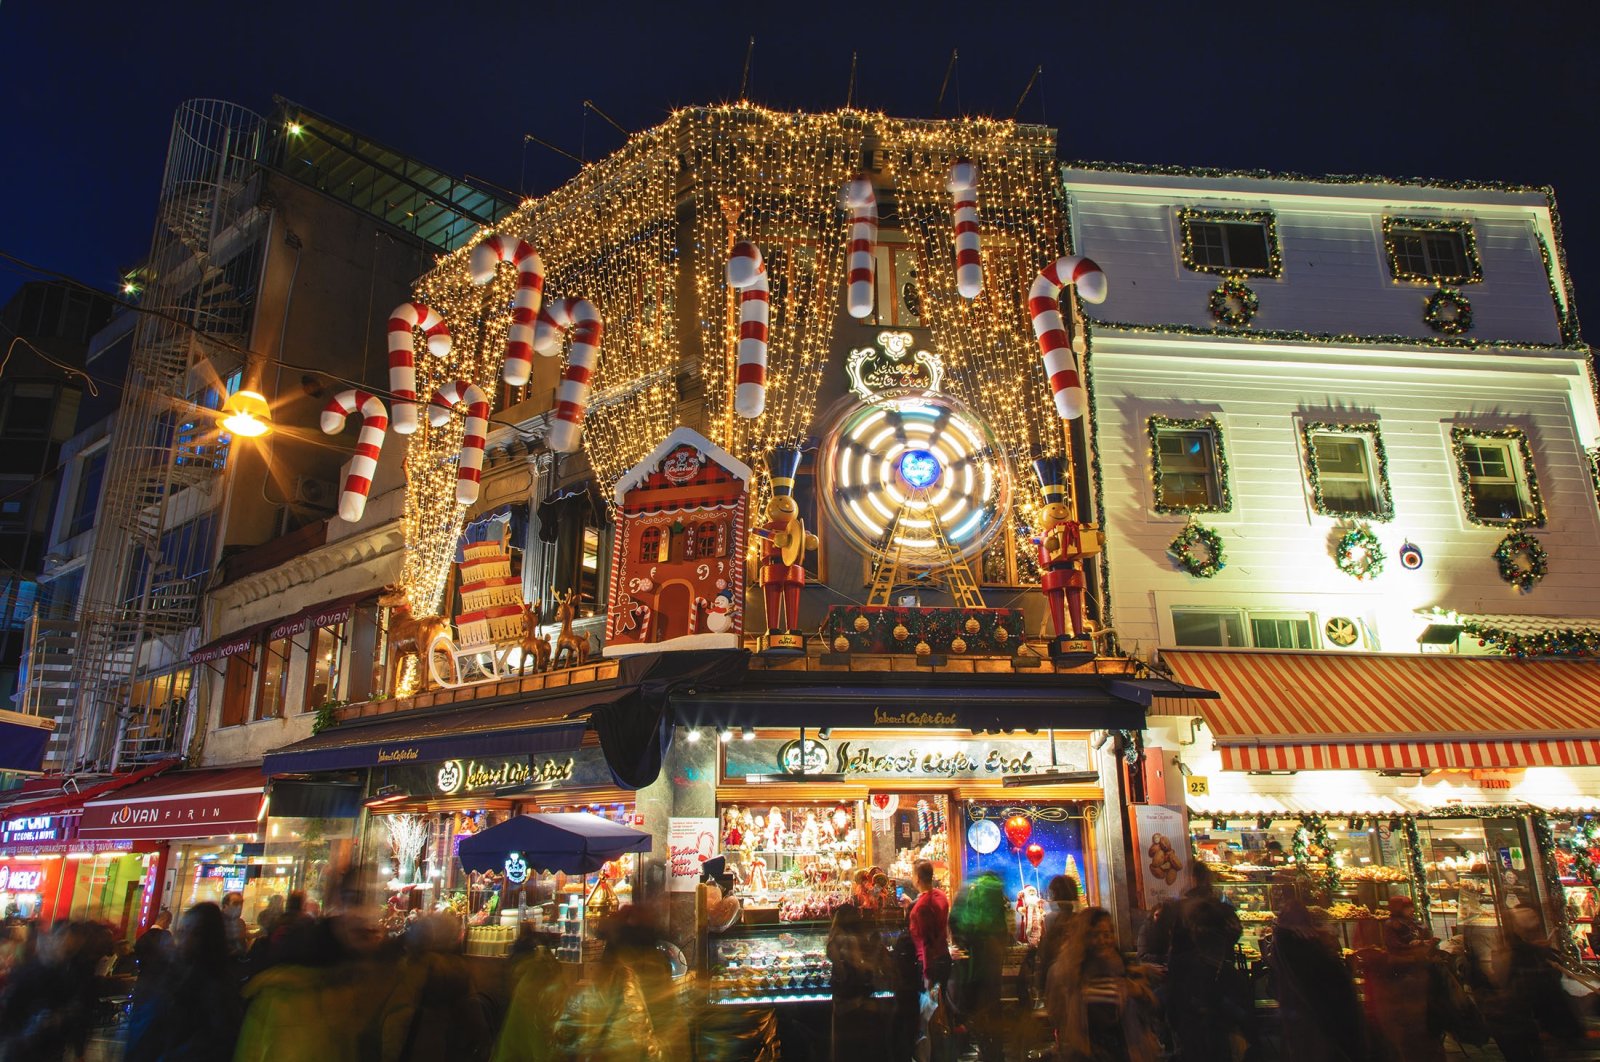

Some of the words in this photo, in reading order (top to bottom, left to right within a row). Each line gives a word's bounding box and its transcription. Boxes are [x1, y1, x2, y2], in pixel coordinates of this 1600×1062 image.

[906, 712, 934, 726] Cafer
[933, 711, 957, 724] Erol
[922, 751, 979, 777] Cafer
[984, 749, 1033, 773] Erol
[1191, 782, 1206, 792] 23
[110, 805, 159, 825] KOVAN
[165, 808, 220, 820] FIRIN
